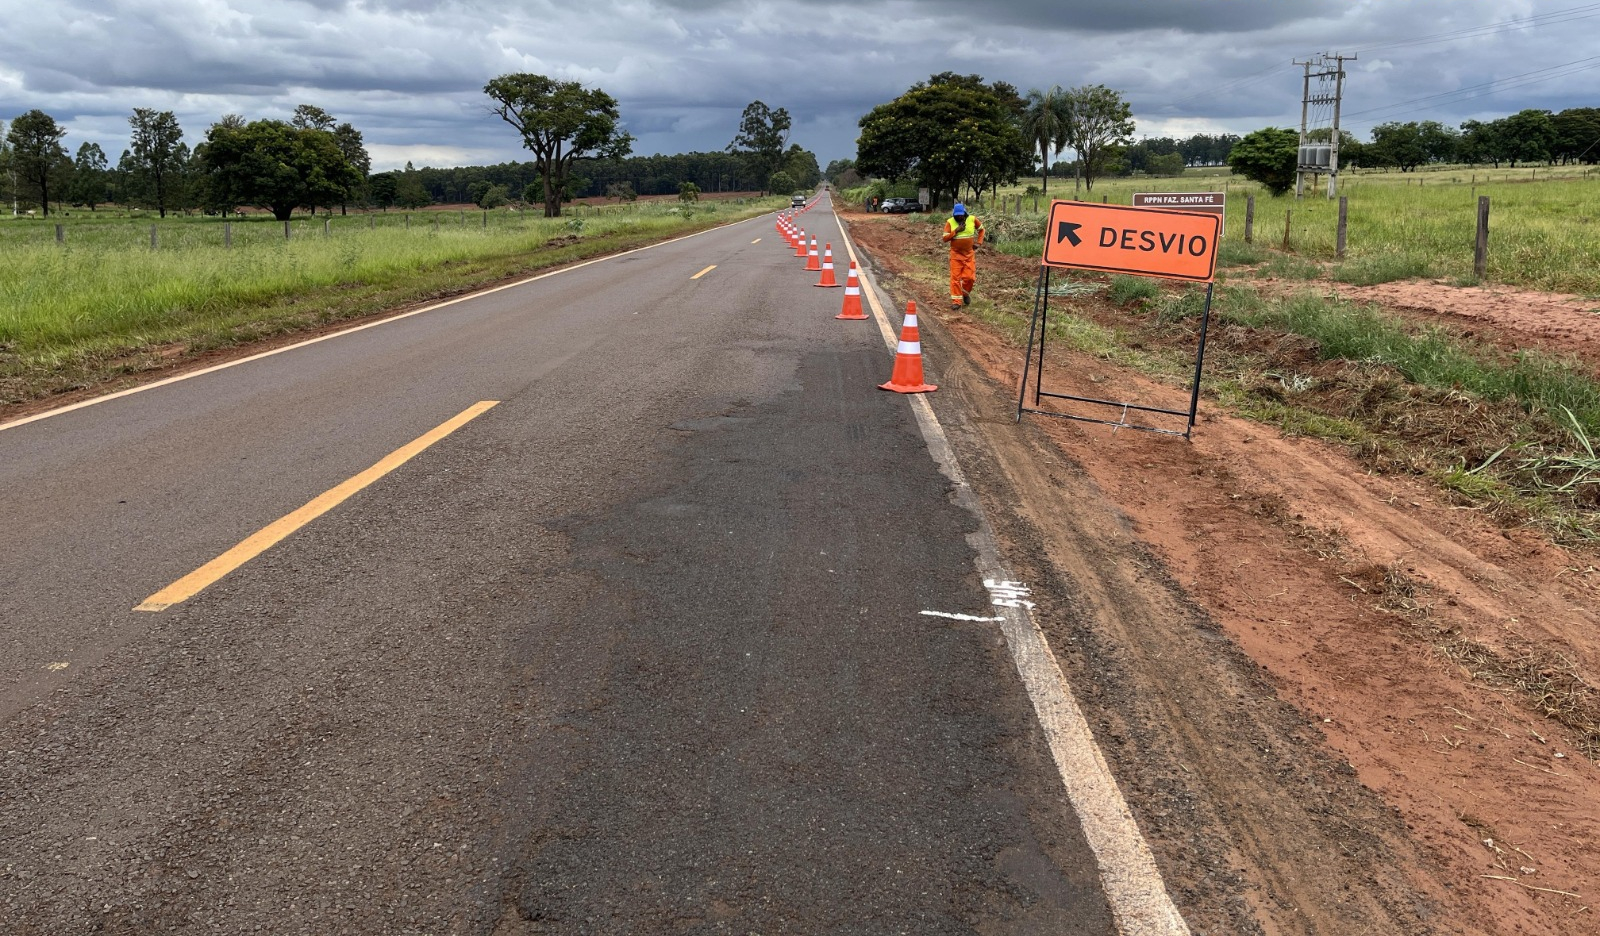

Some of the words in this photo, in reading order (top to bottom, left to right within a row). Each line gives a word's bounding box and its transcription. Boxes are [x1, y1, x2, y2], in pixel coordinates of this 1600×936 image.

[1144, 196, 1162, 204] RPPN
[1163, 196, 1179, 204] FAZ.
[1180, 196, 1203, 204] SANTA
[1204, 194, 1214, 203] FÉ
[1099, 226, 1207, 257] DESVIO
